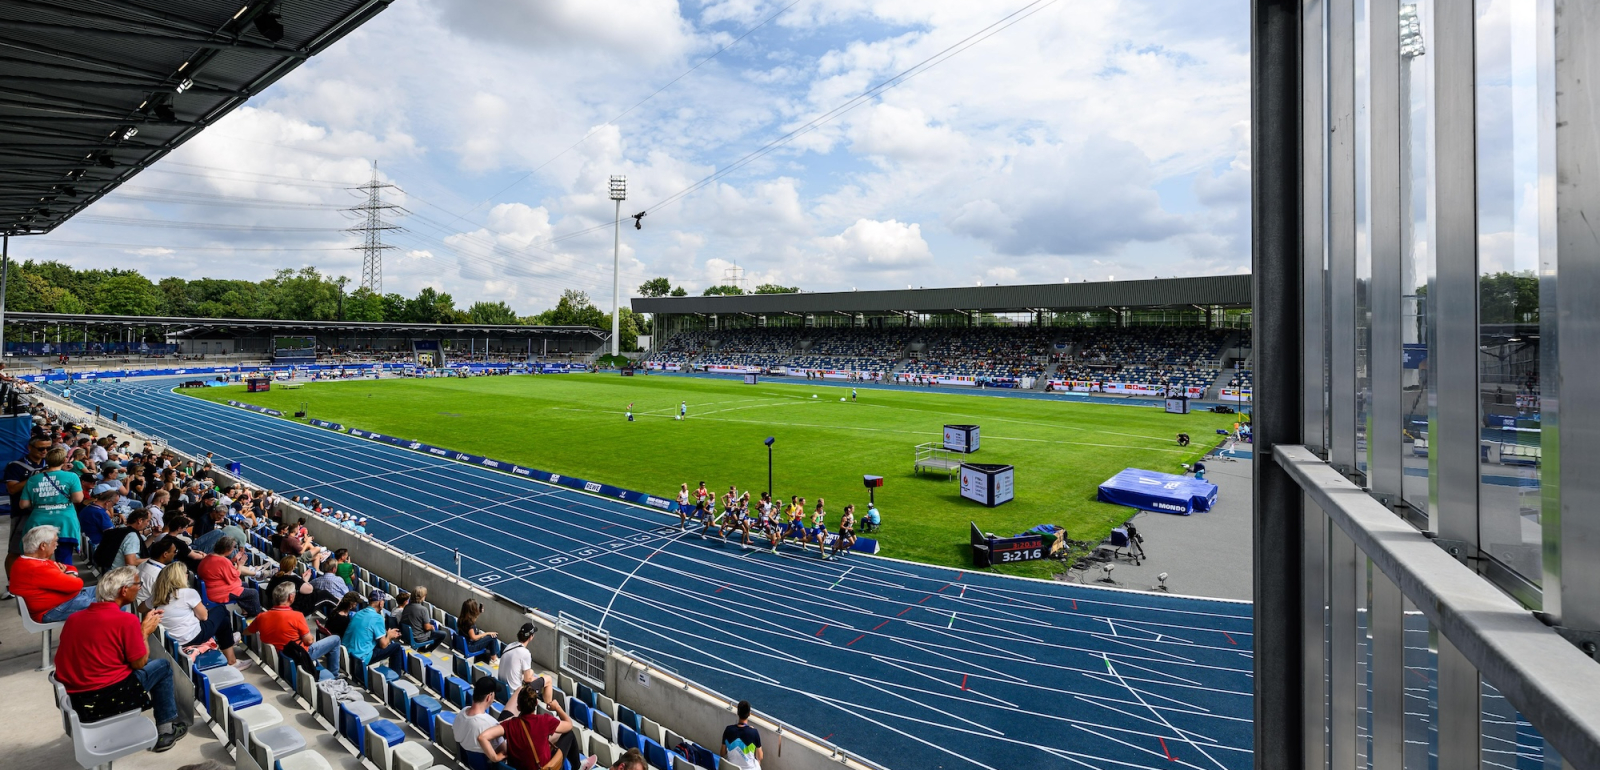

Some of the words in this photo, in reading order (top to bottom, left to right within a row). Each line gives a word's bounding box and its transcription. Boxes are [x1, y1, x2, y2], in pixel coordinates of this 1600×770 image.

[38, 490, 60, 498] GAMES
[1158, 502, 1186, 512] MONDO
[609, 541, 627, 549] 4
[1012, 540, 1042, 549] 3:20.36
[578, 548, 599, 557] 5
[1002, 549, 1042, 562] 3:21.6
[548, 556, 569, 565] 6
[515, 565, 537, 573] 7
[478, 574, 502, 583] 8
